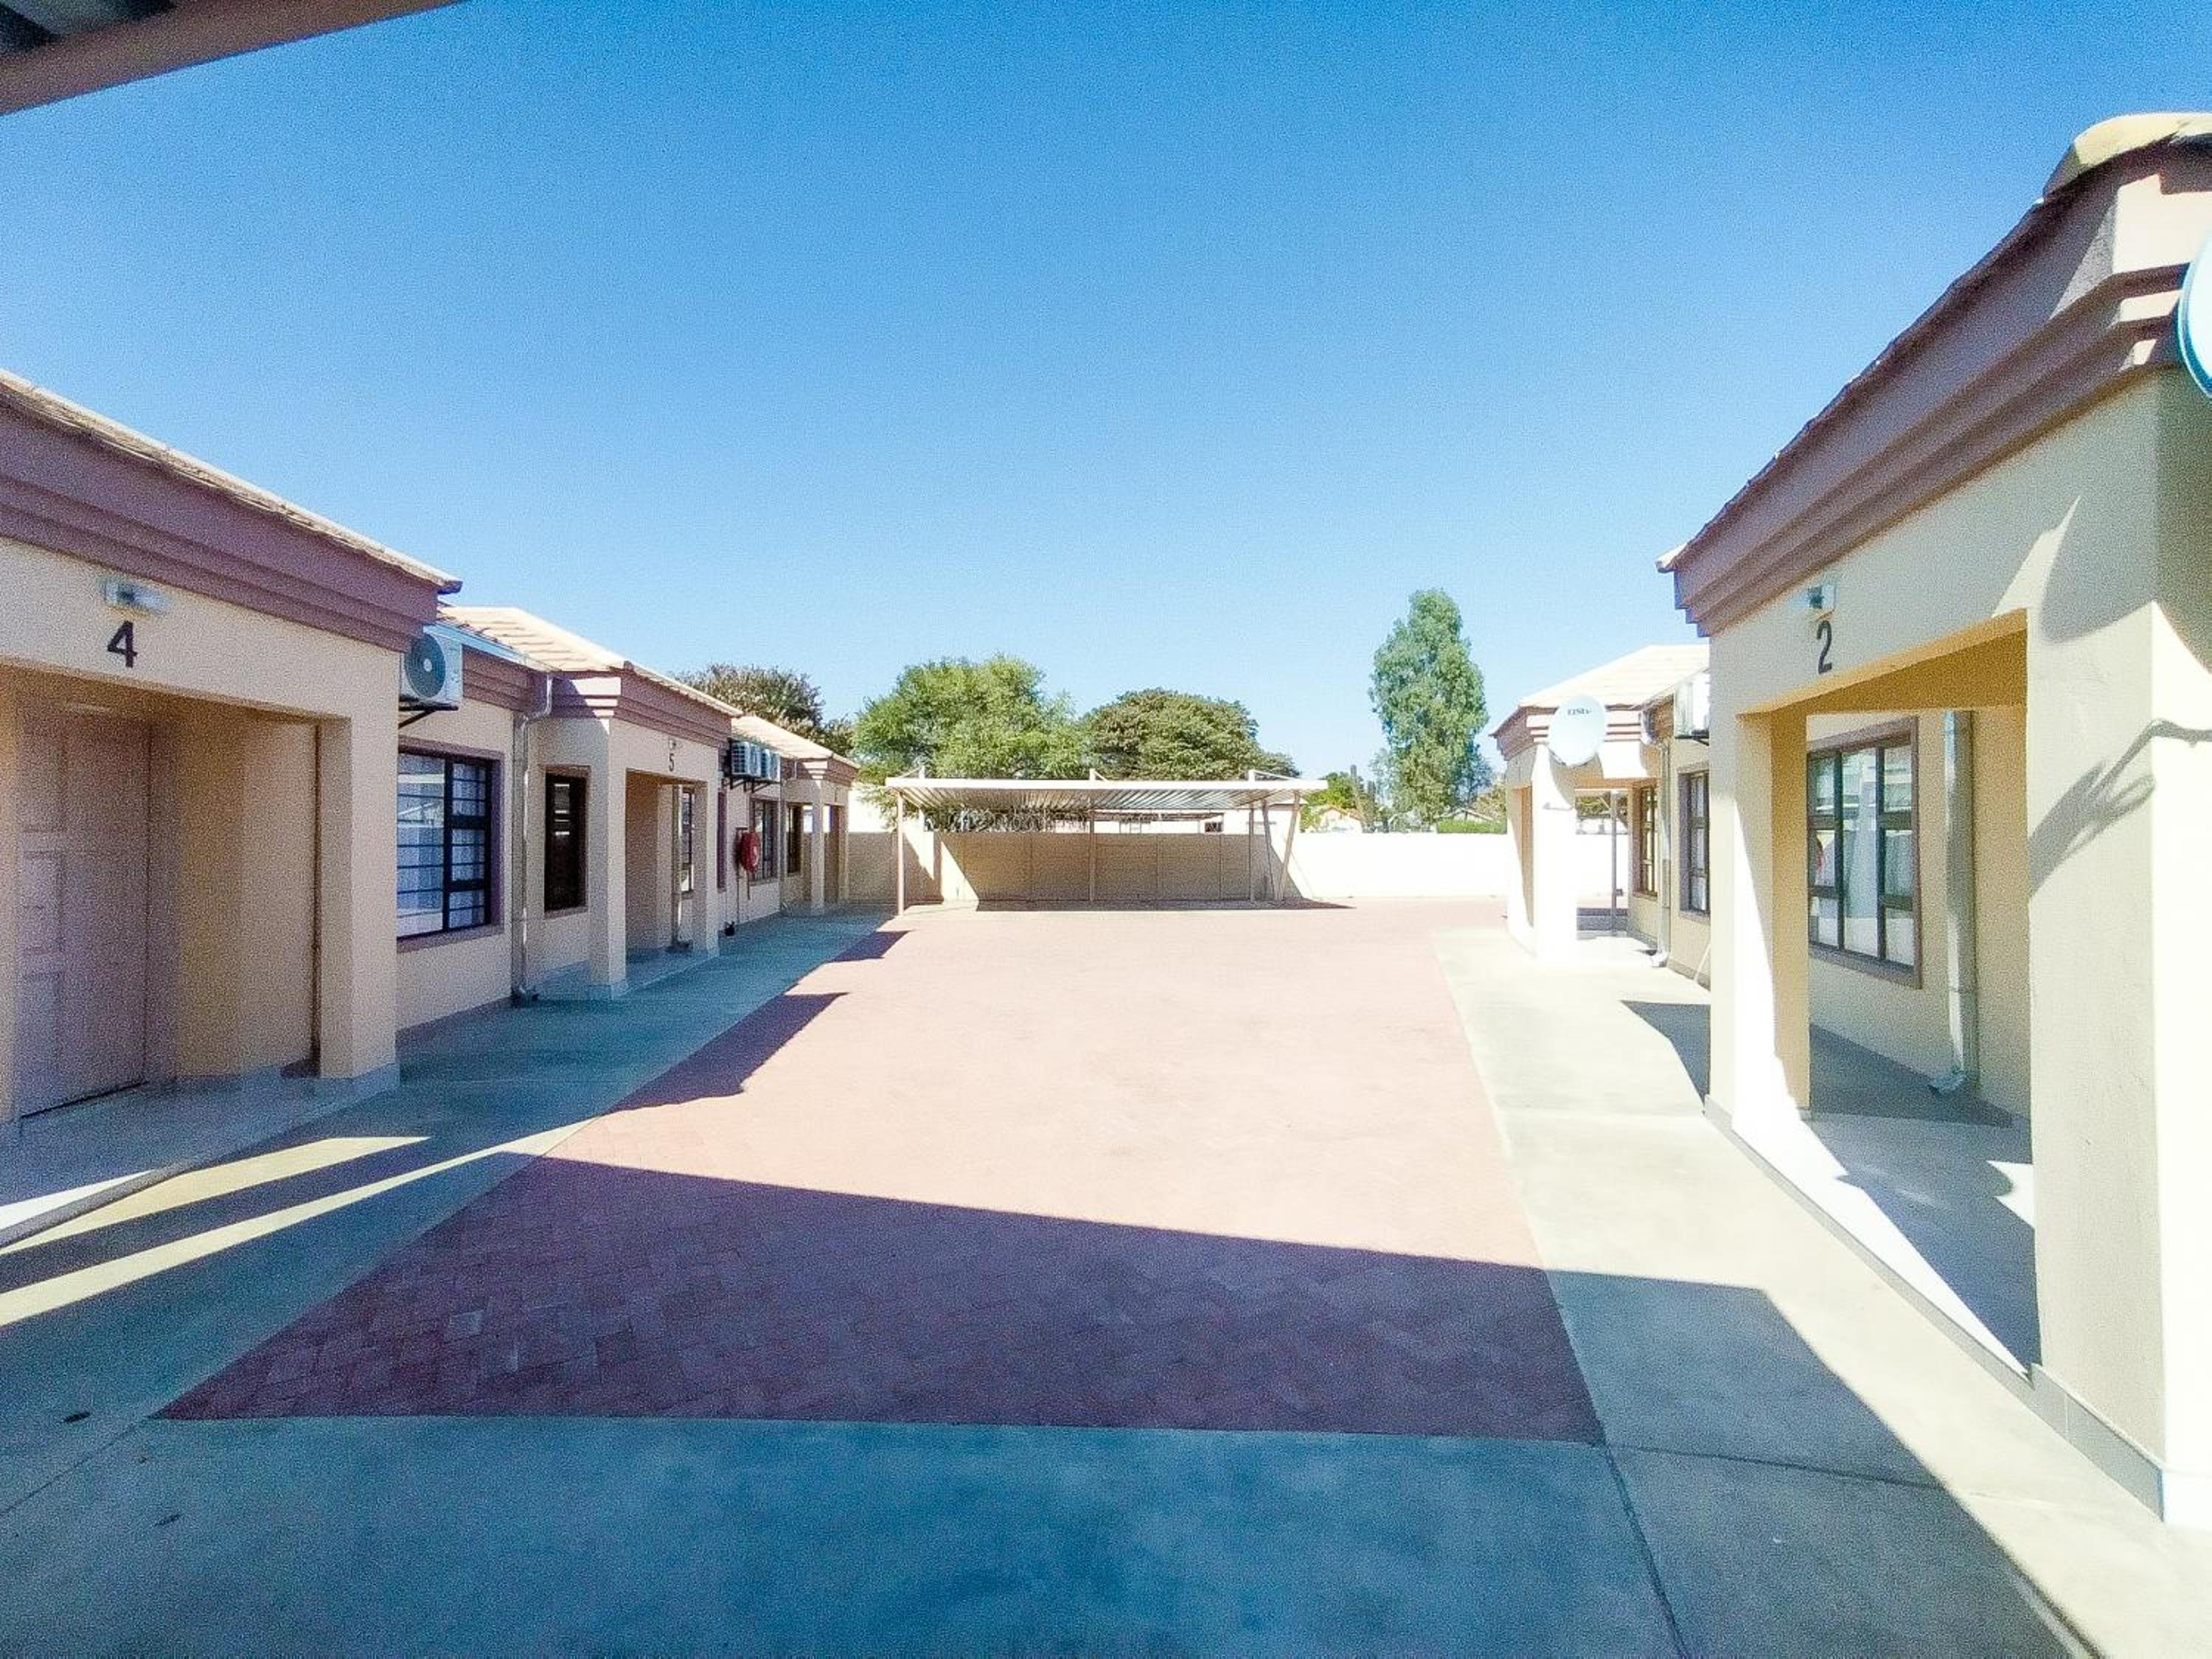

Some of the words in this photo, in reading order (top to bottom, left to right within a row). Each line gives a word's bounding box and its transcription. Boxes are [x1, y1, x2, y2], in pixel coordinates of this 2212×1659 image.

[107, 620, 138, 668] 4
[1817, 620, 1832, 674] 2
[669, 753, 675, 772] 5
